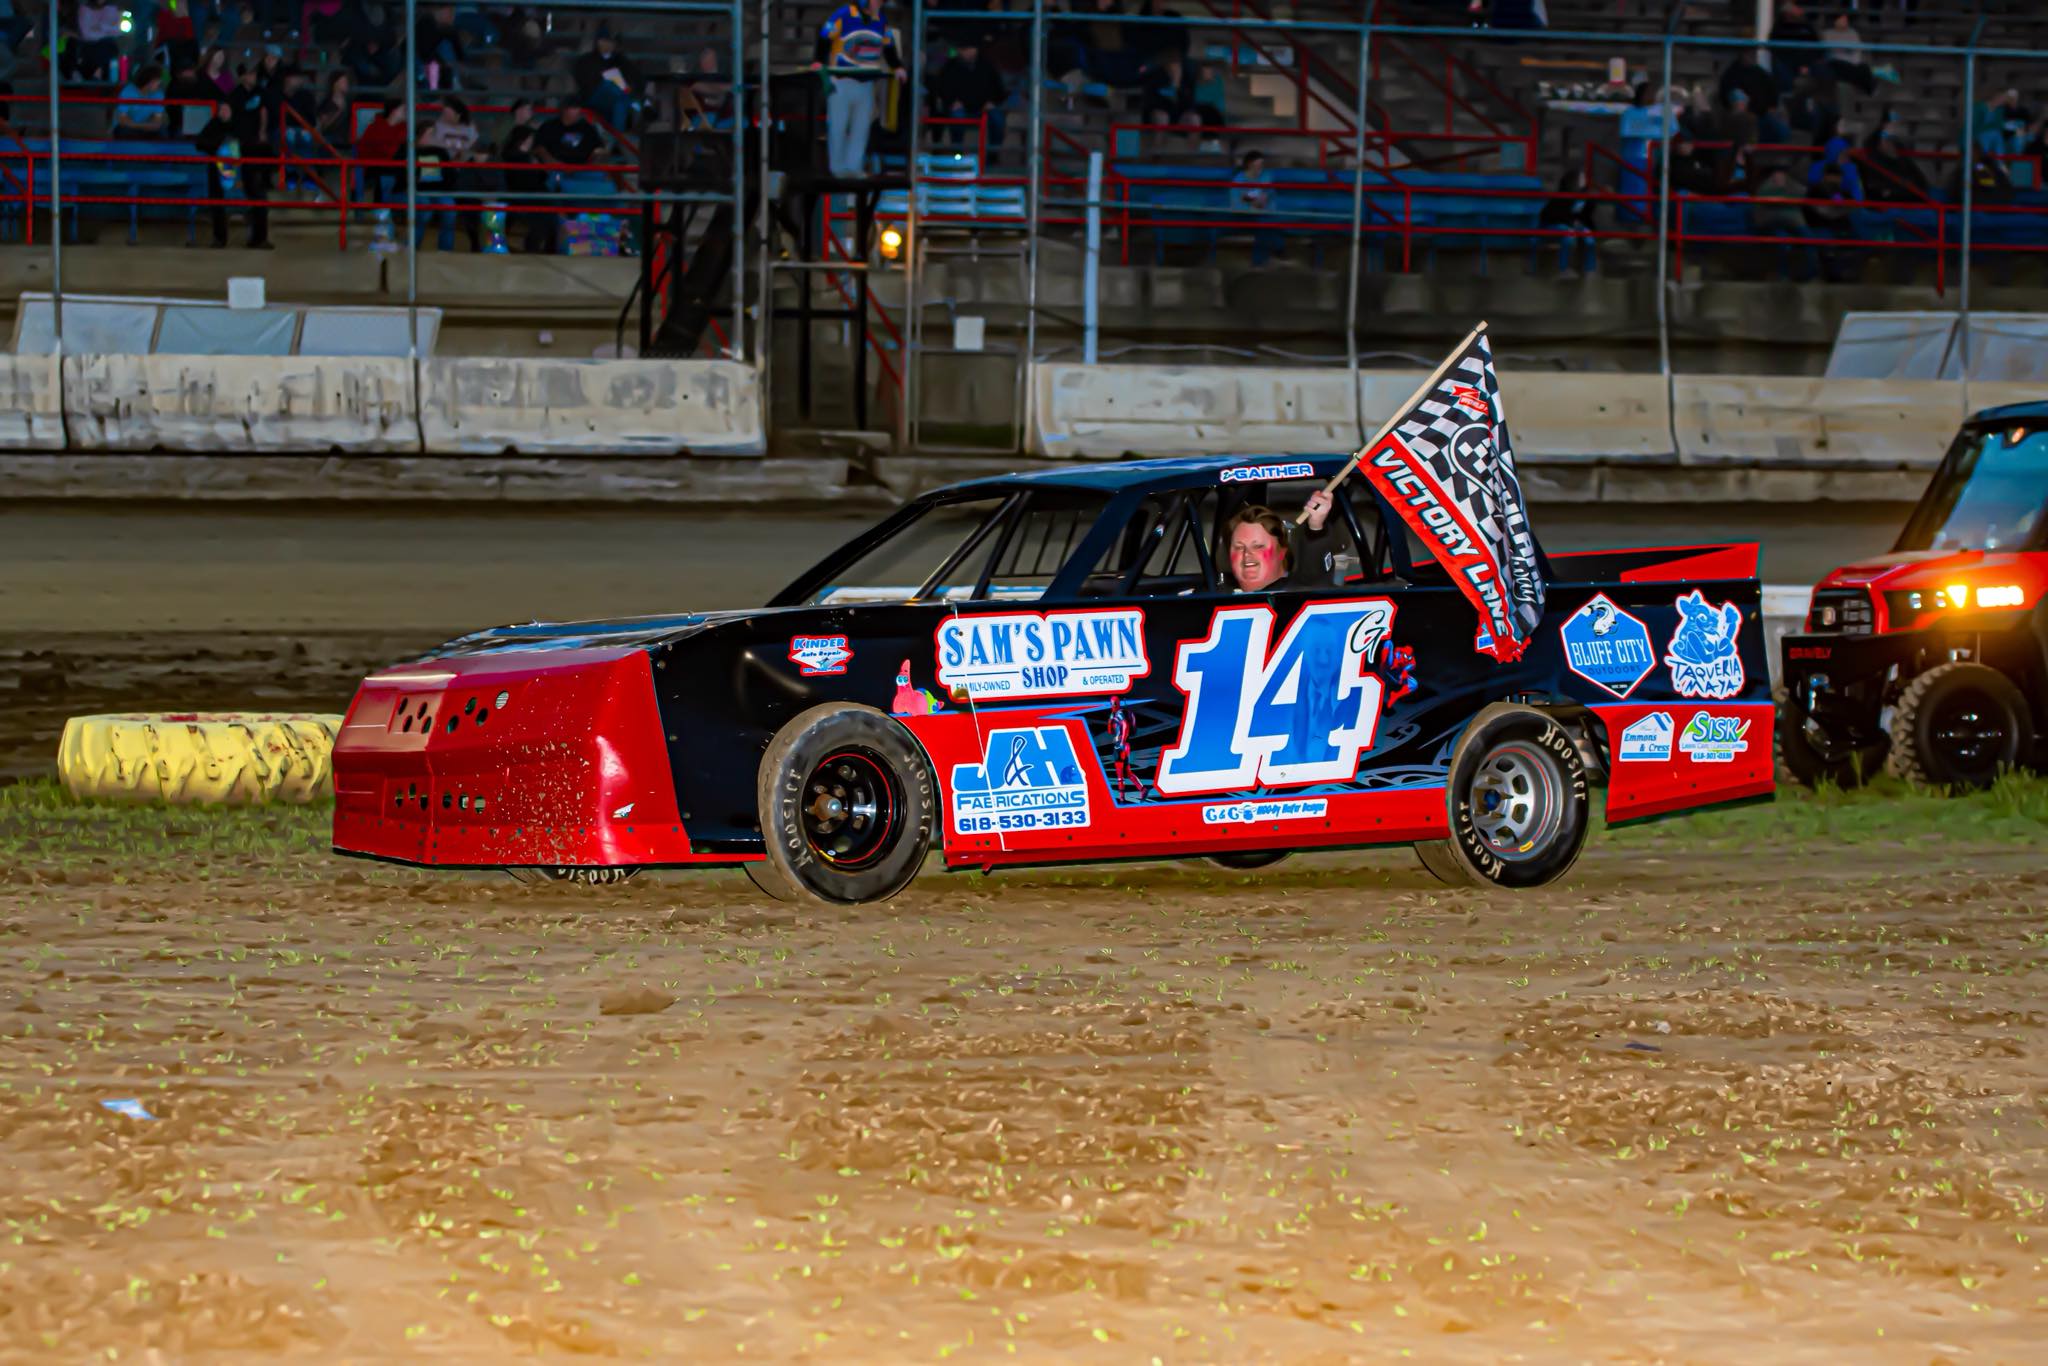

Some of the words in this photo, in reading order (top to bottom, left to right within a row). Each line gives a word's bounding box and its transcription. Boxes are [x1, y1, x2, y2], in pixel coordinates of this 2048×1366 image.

[1372, 447, 1479, 556] VICTORY
[1464, 562, 1508, 637] LANE
[794, 638, 845, 650] KINDER
[944, 621, 1045, 666] SAM'S
[1050, 617, 1138, 661] PAWN
[1570, 640, 1613, 667] BLUFF
[1614, 638, 1648, 664] CITY
[1022, 665, 1068, 688] SHOP
[1082, 676, 1089, 686] &
[1089, 674, 1125, 686] OPERATED
[1668, 657, 1741, 682] TAQUERIA
[1168, 612, 1371, 775] 14
[1351, 609, 1385, 663] G
[1624, 733, 1657, 742] Emmons
[1692, 713, 1739, 742] SISK
[958, 810, 1087, 832] 618-530-3133
